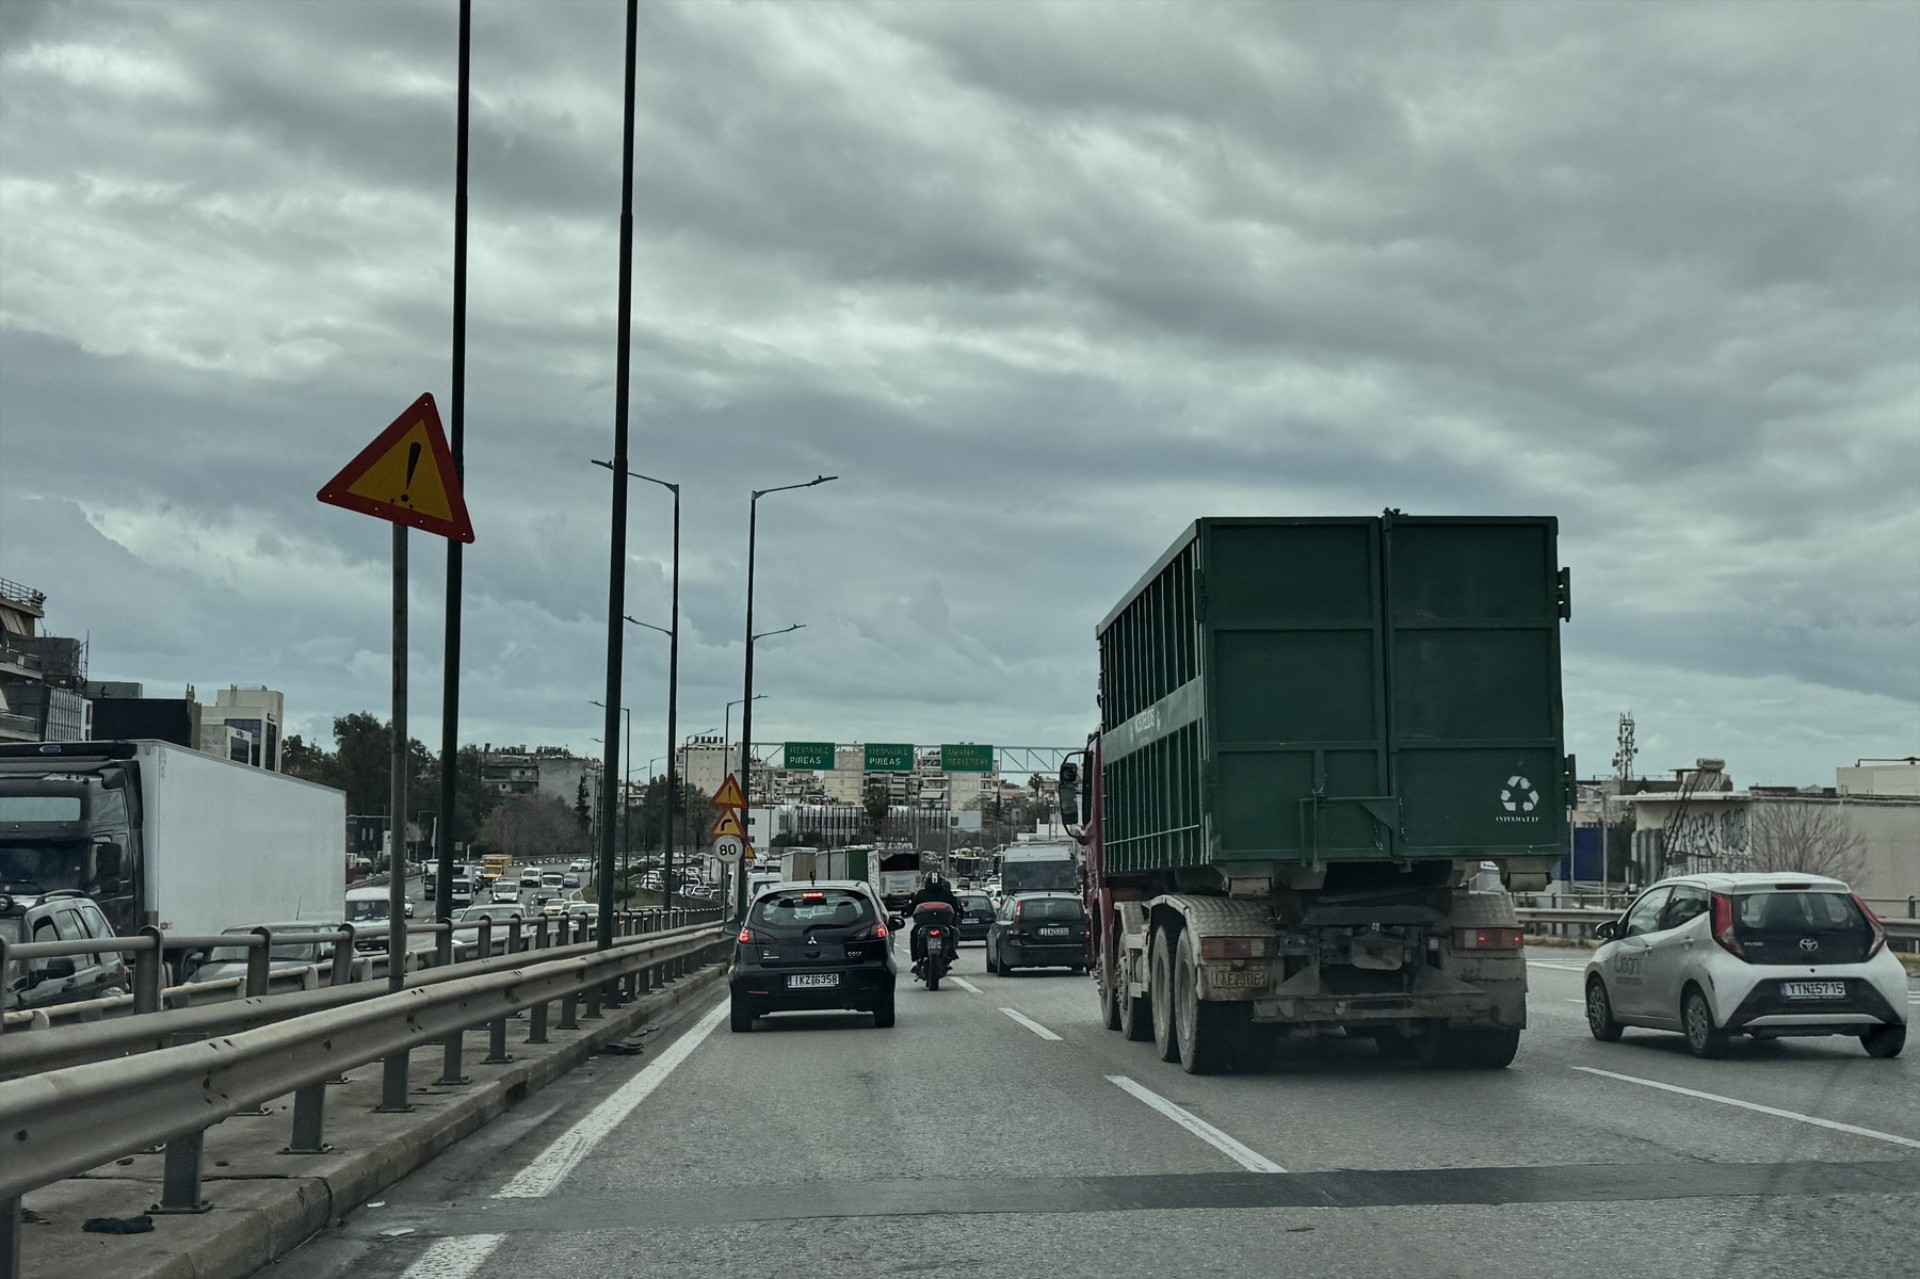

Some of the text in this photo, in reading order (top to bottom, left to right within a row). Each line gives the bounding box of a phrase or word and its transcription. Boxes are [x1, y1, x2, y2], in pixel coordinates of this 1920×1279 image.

[789, 756, 821, 764] PIREAS
[869, 757, 901, 766] PIREAS
[719, 843, 737, 856] 80
